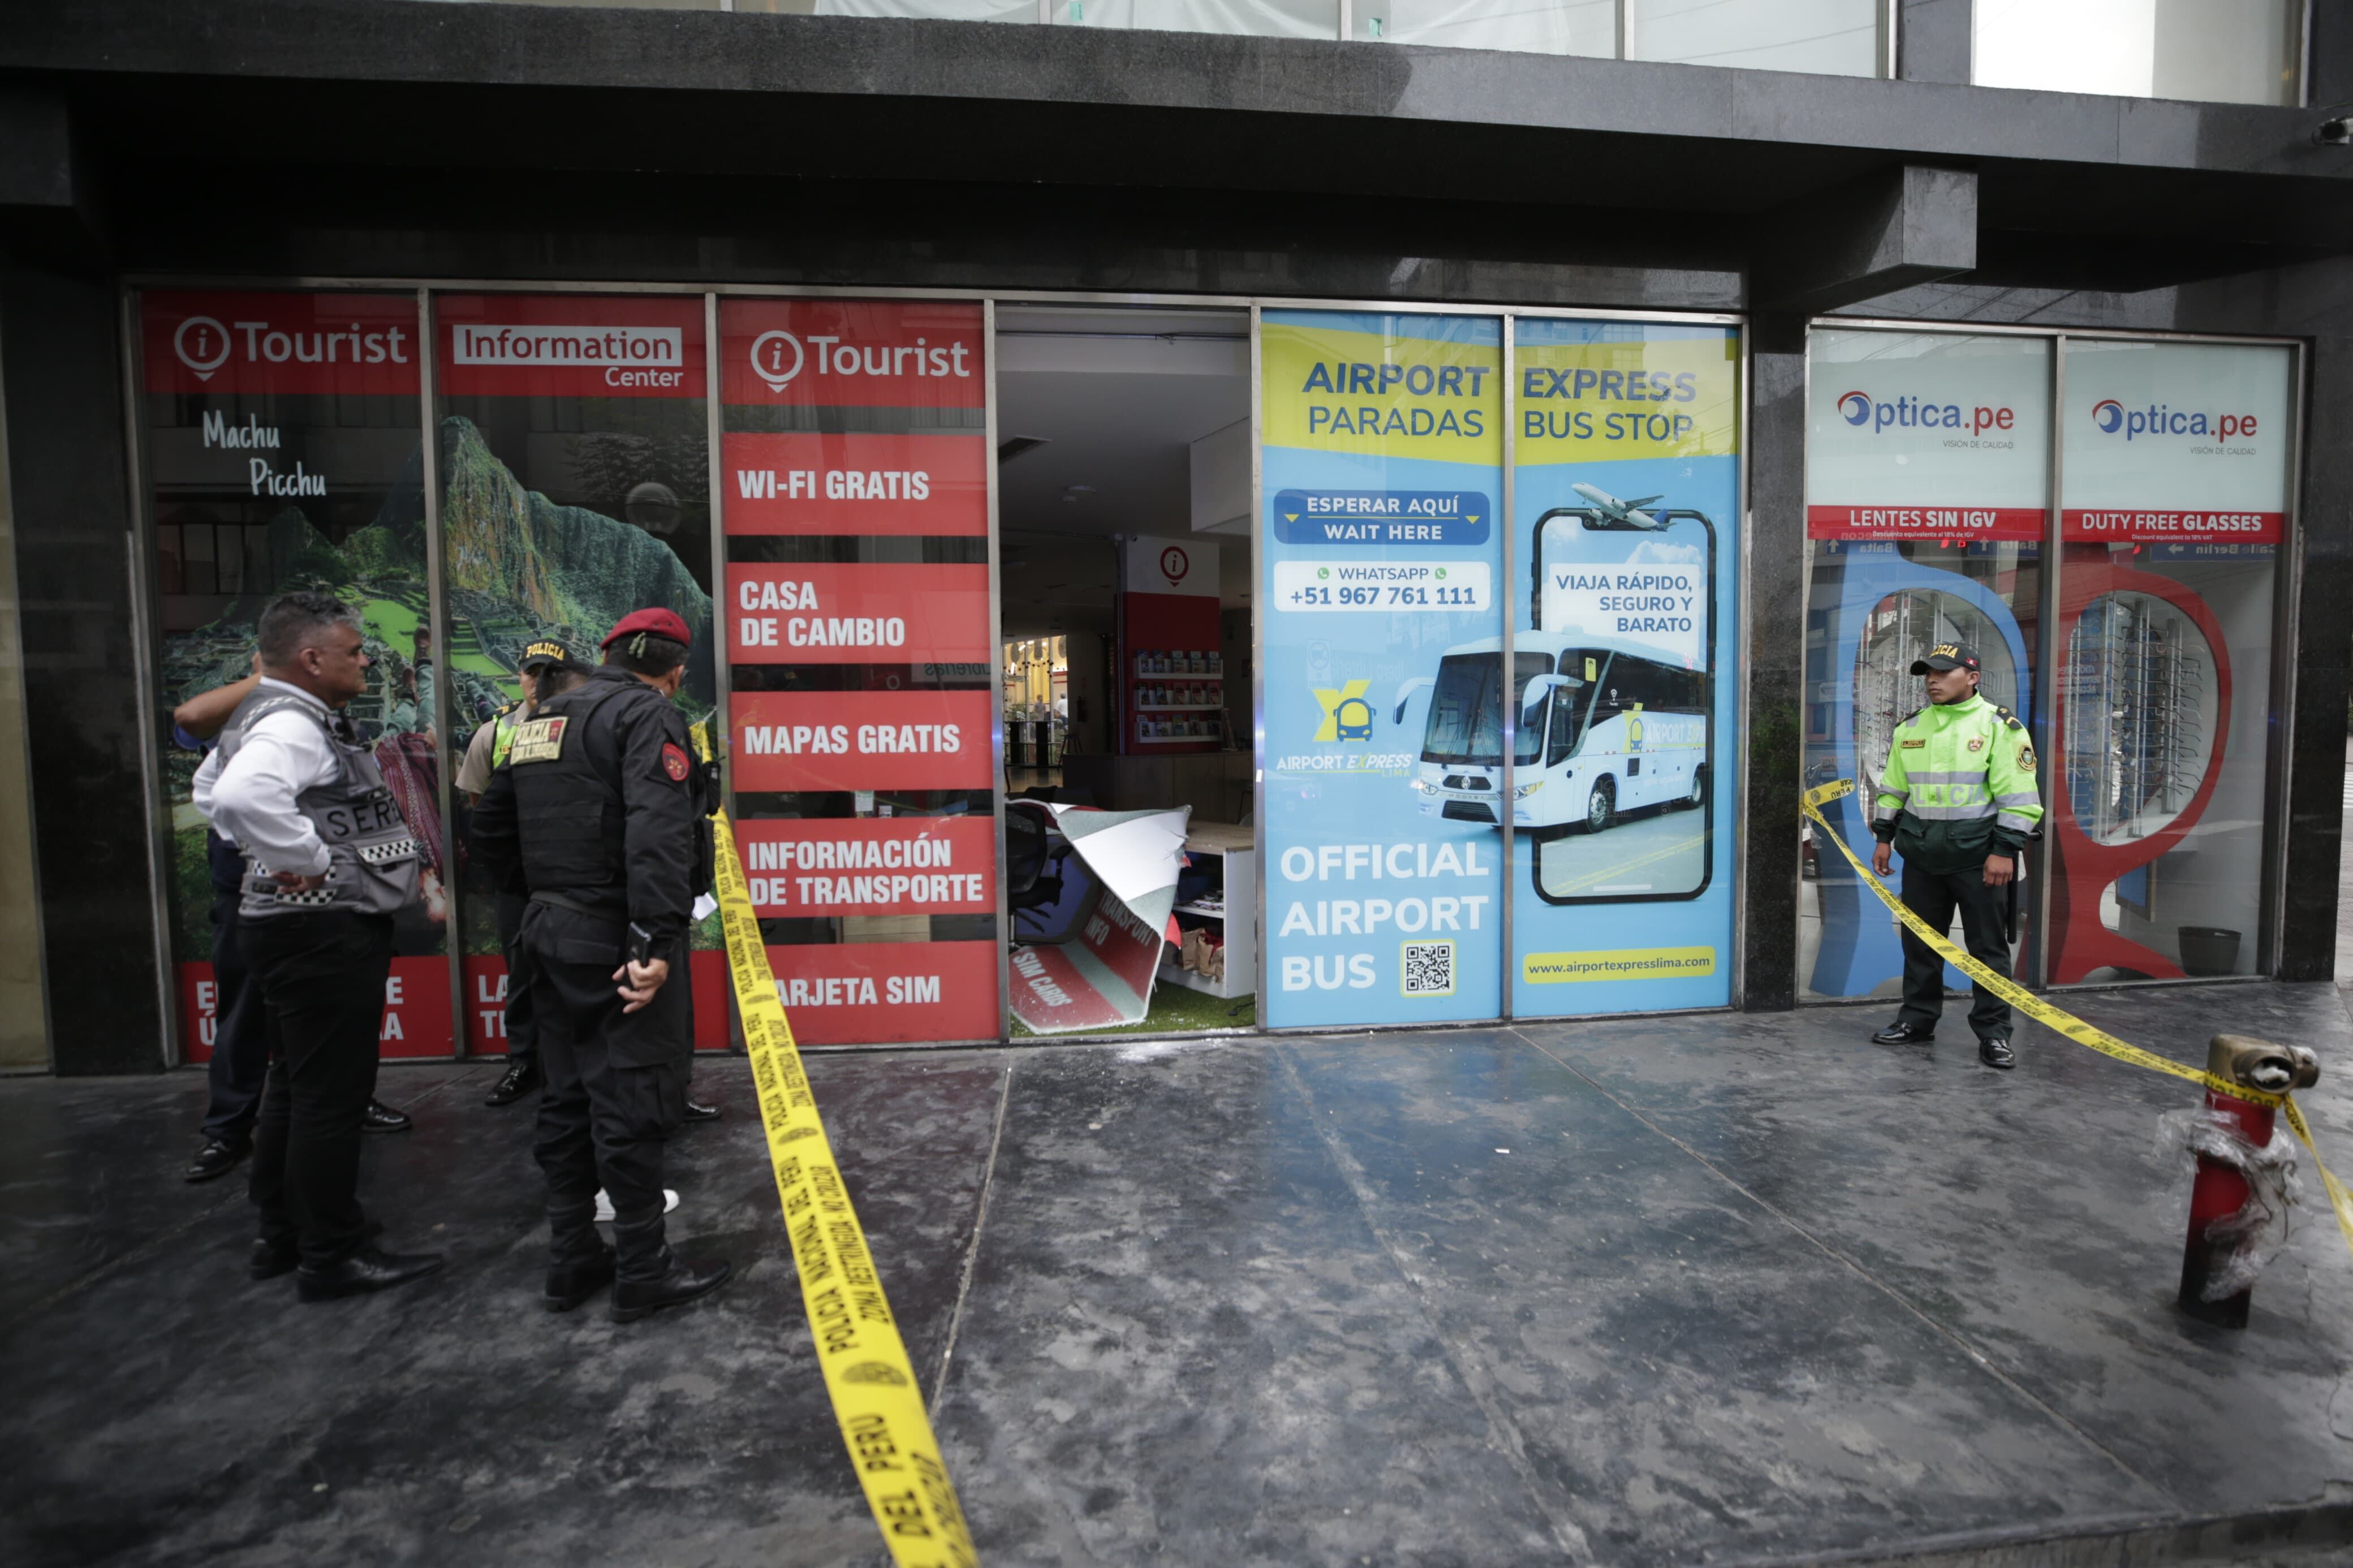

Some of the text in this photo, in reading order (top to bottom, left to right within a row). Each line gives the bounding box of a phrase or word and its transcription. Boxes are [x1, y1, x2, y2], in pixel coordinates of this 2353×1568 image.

[234, 322, 408, 364] Tourist
[464, 328, 673, 360] Information
[807, 336, 970, 378] Tourist
[605, 366, 684, 387] Center
[1302, 362, 1490, 397] AIRPORT
[1523, 368, 1697, 403] EXPRESS
[202, 409, 281, 449] Machu
[1309, 405, 1485, 438] PARADAS
[1524, 411, 1693, 442] BUS STOP
[1942, 439, 2014, 450] VISIÓN DE CALIDAD
[2226, 447, 2256, 456] CALIDAD
[249, 457, 327, 496] Picchu
[737, 470, 930, 500] WI-FI GRATIS
[1307, 495, 1460, 517] ESPERAR AQUÍ
[1850, 509, 1996, 528] LENTES SIN IGV
[1324, 524, 1442, 540] WAIT HERE
[2082, 513, 2262, 531] DUTY FREE GLASSES
[1338, 567, 1429, 581] WHATSAPP
[1556, 571, 1693, 593] VIAJA RÁPIDO,
[739, 581, 818, 611] CASA
[1290, 586, 1476, 605] +51 967 761 111
[1599, 596, 1693, 611] SEGURO Y
[740, 617, 905, 647] DE CAMBIO
[1617, 617, 1692, 632] BARATO
[525, 642, 564, 660] POLICIA
[744, 725, 848, 755] MAPAS
[857, 724, 960, 754] GRATIS
[1275, 751, 1413, 771] AIRPORT EXPRESS
[1382, 769, 1411, 779] LIMA
[1830, 787, 1851, 800] PERU
[748, 832, 951, 871] INFORMACIÓN
[1280, 841, 1489, 882] OFFICIAL
[749, 874, 984, 906] DE TRANSPORTE
[1085, 913, 1110, 946] INFO
[1278, 895, 1489, 937] AIRPORT
[1013, 952, 1073, 1007] SIM CARDS
[1282, 953, 1376, 992] BUS
[1528, 957, 1710, 974] www.airportexpresslima.com
[1959, 953, 1989, 972] POLICIA
[1986, 973, 2026, 996] NACIONAL
[774, 975, 941, 1007] ARJETA SIM
[765, 1092, 790, 1132] POLICIA
[777, 1155, 861, 1356] POLICIA NACIONAL DEL PERU
[847, 1413, 933, 1539] DEL PERU
